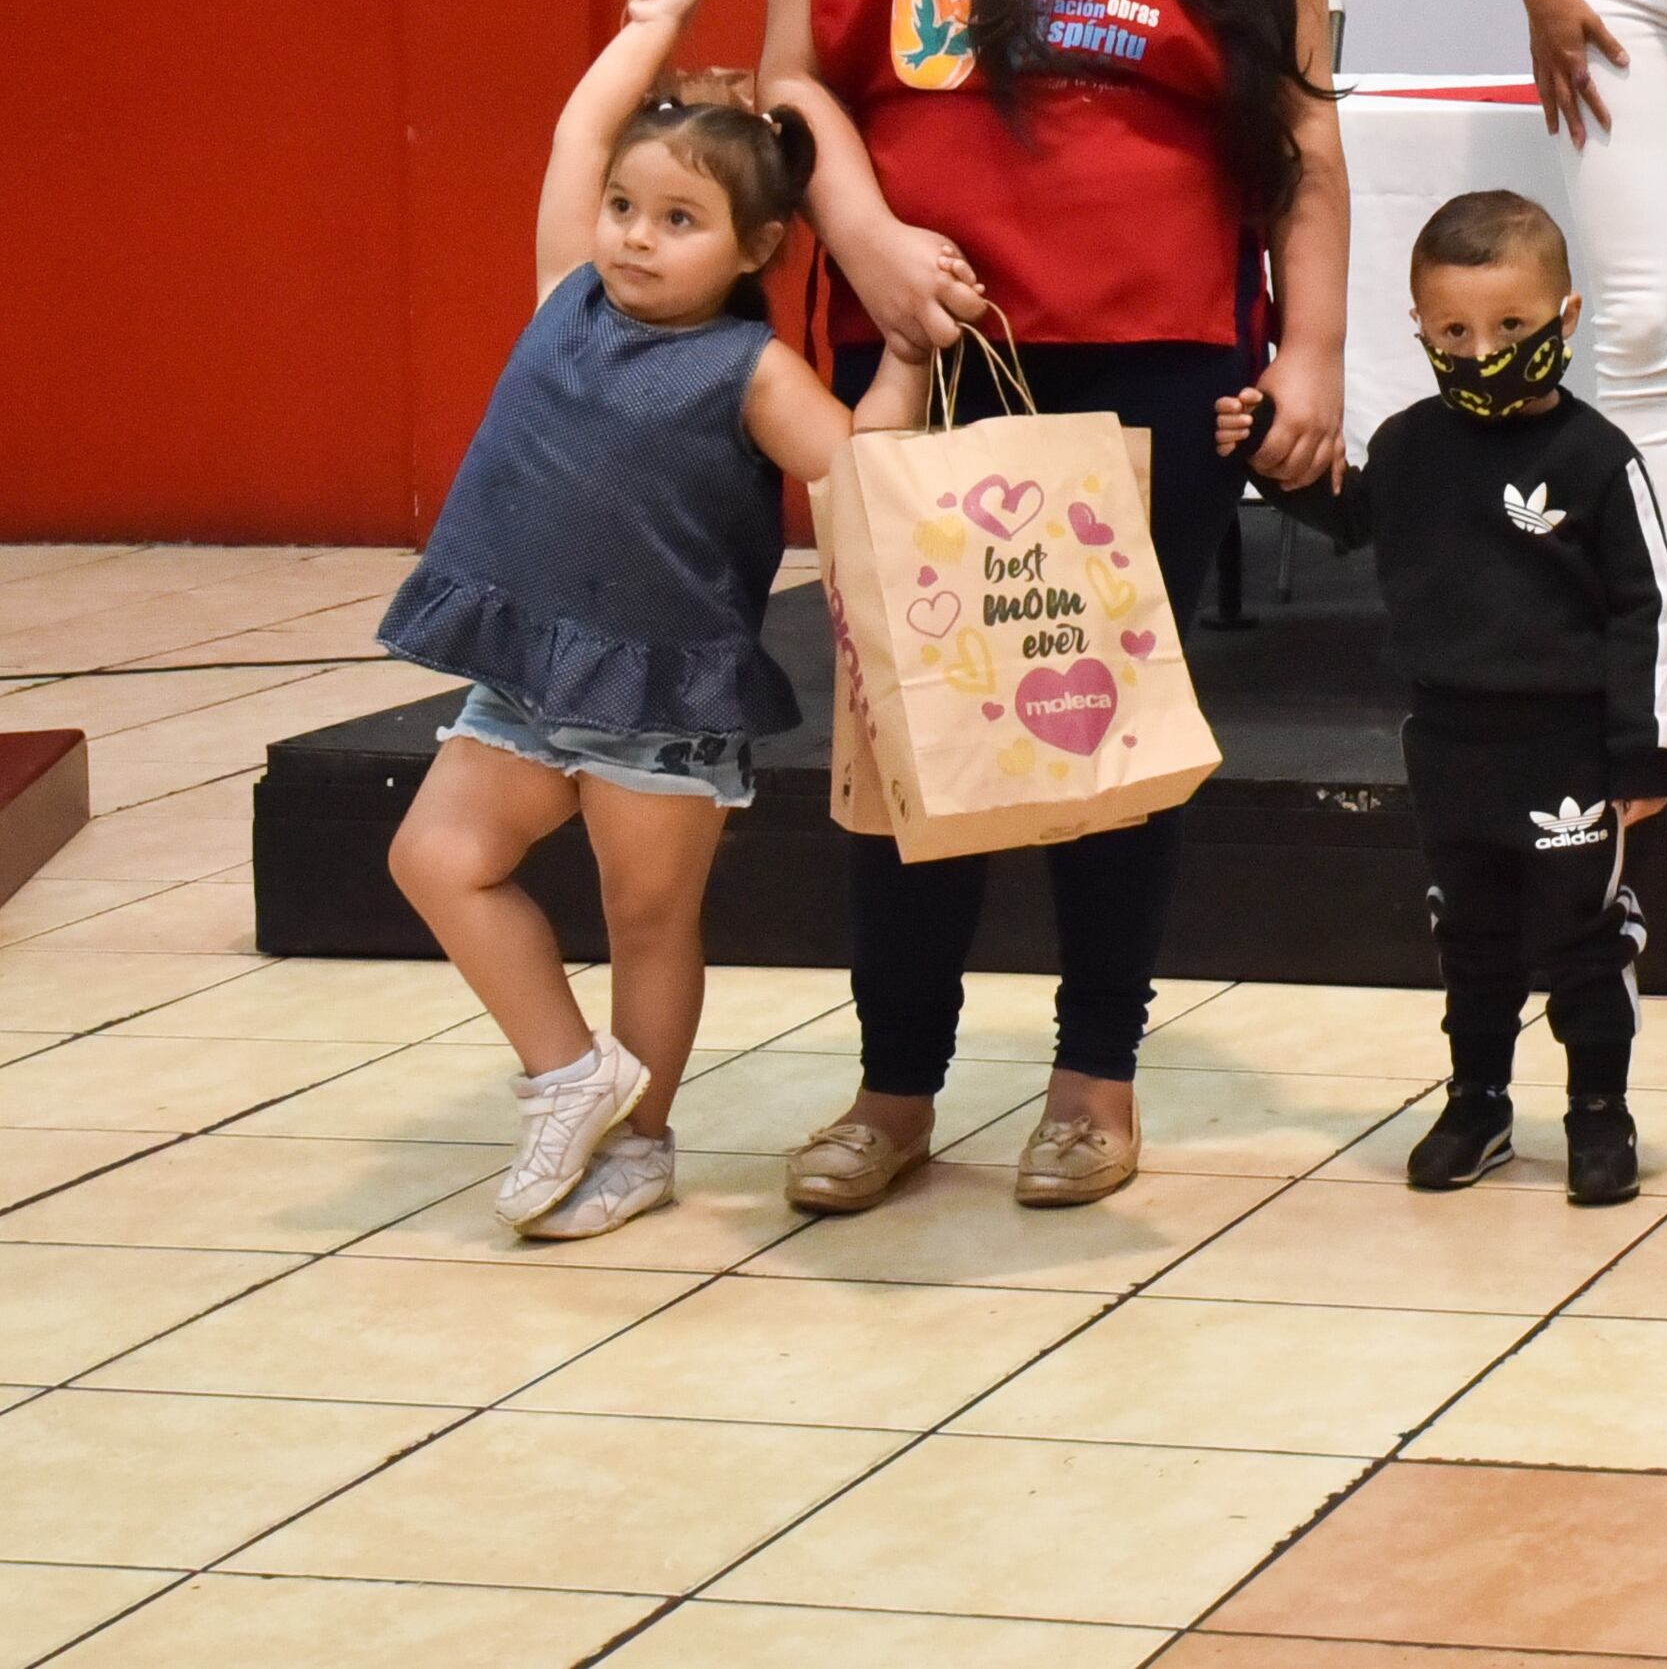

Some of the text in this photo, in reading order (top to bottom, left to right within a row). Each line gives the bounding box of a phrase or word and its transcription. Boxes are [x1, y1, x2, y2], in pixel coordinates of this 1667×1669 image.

[983, 542, 1048, 584] best
[982, 585, 1087, 627] mom
[1021, 622, 1090, 660] ever
[1024, 689, 1112, 717] moleca
[1534, 827, 1609, 850] adidas
